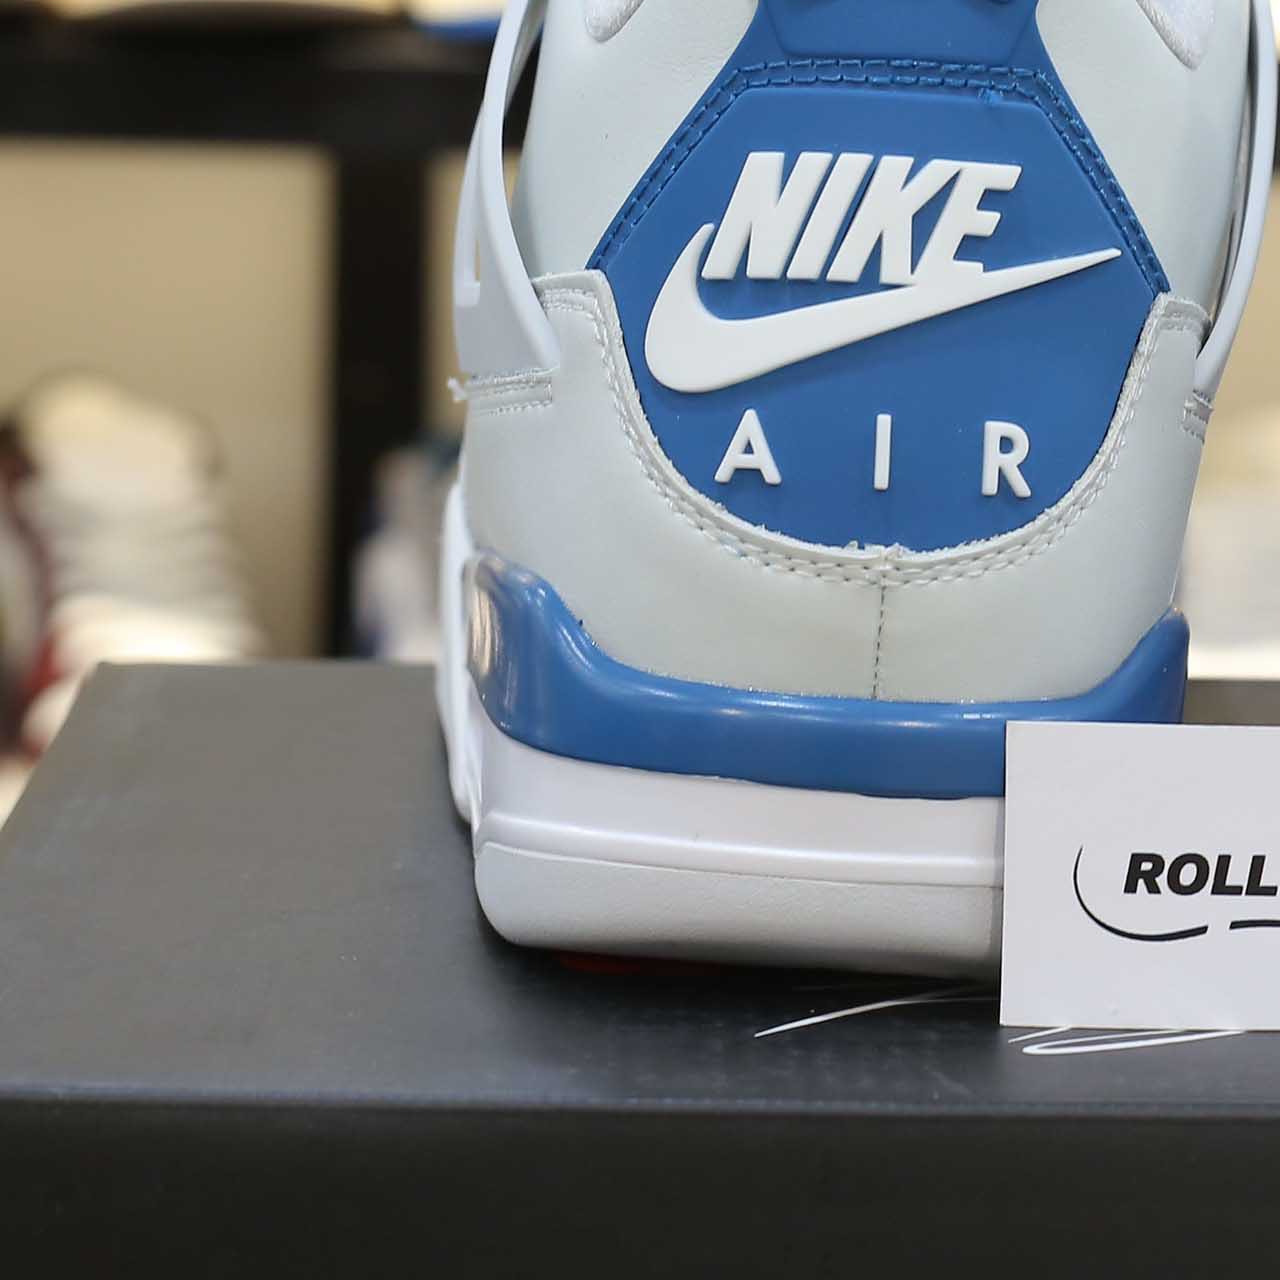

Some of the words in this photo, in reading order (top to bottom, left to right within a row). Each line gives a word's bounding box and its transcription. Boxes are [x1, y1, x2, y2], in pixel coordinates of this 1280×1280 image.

[701, 151, 1022, 285] NIKE
[714, 408, 1032, 498] AIR
[1123, 852, 1278, 897] ROLL
